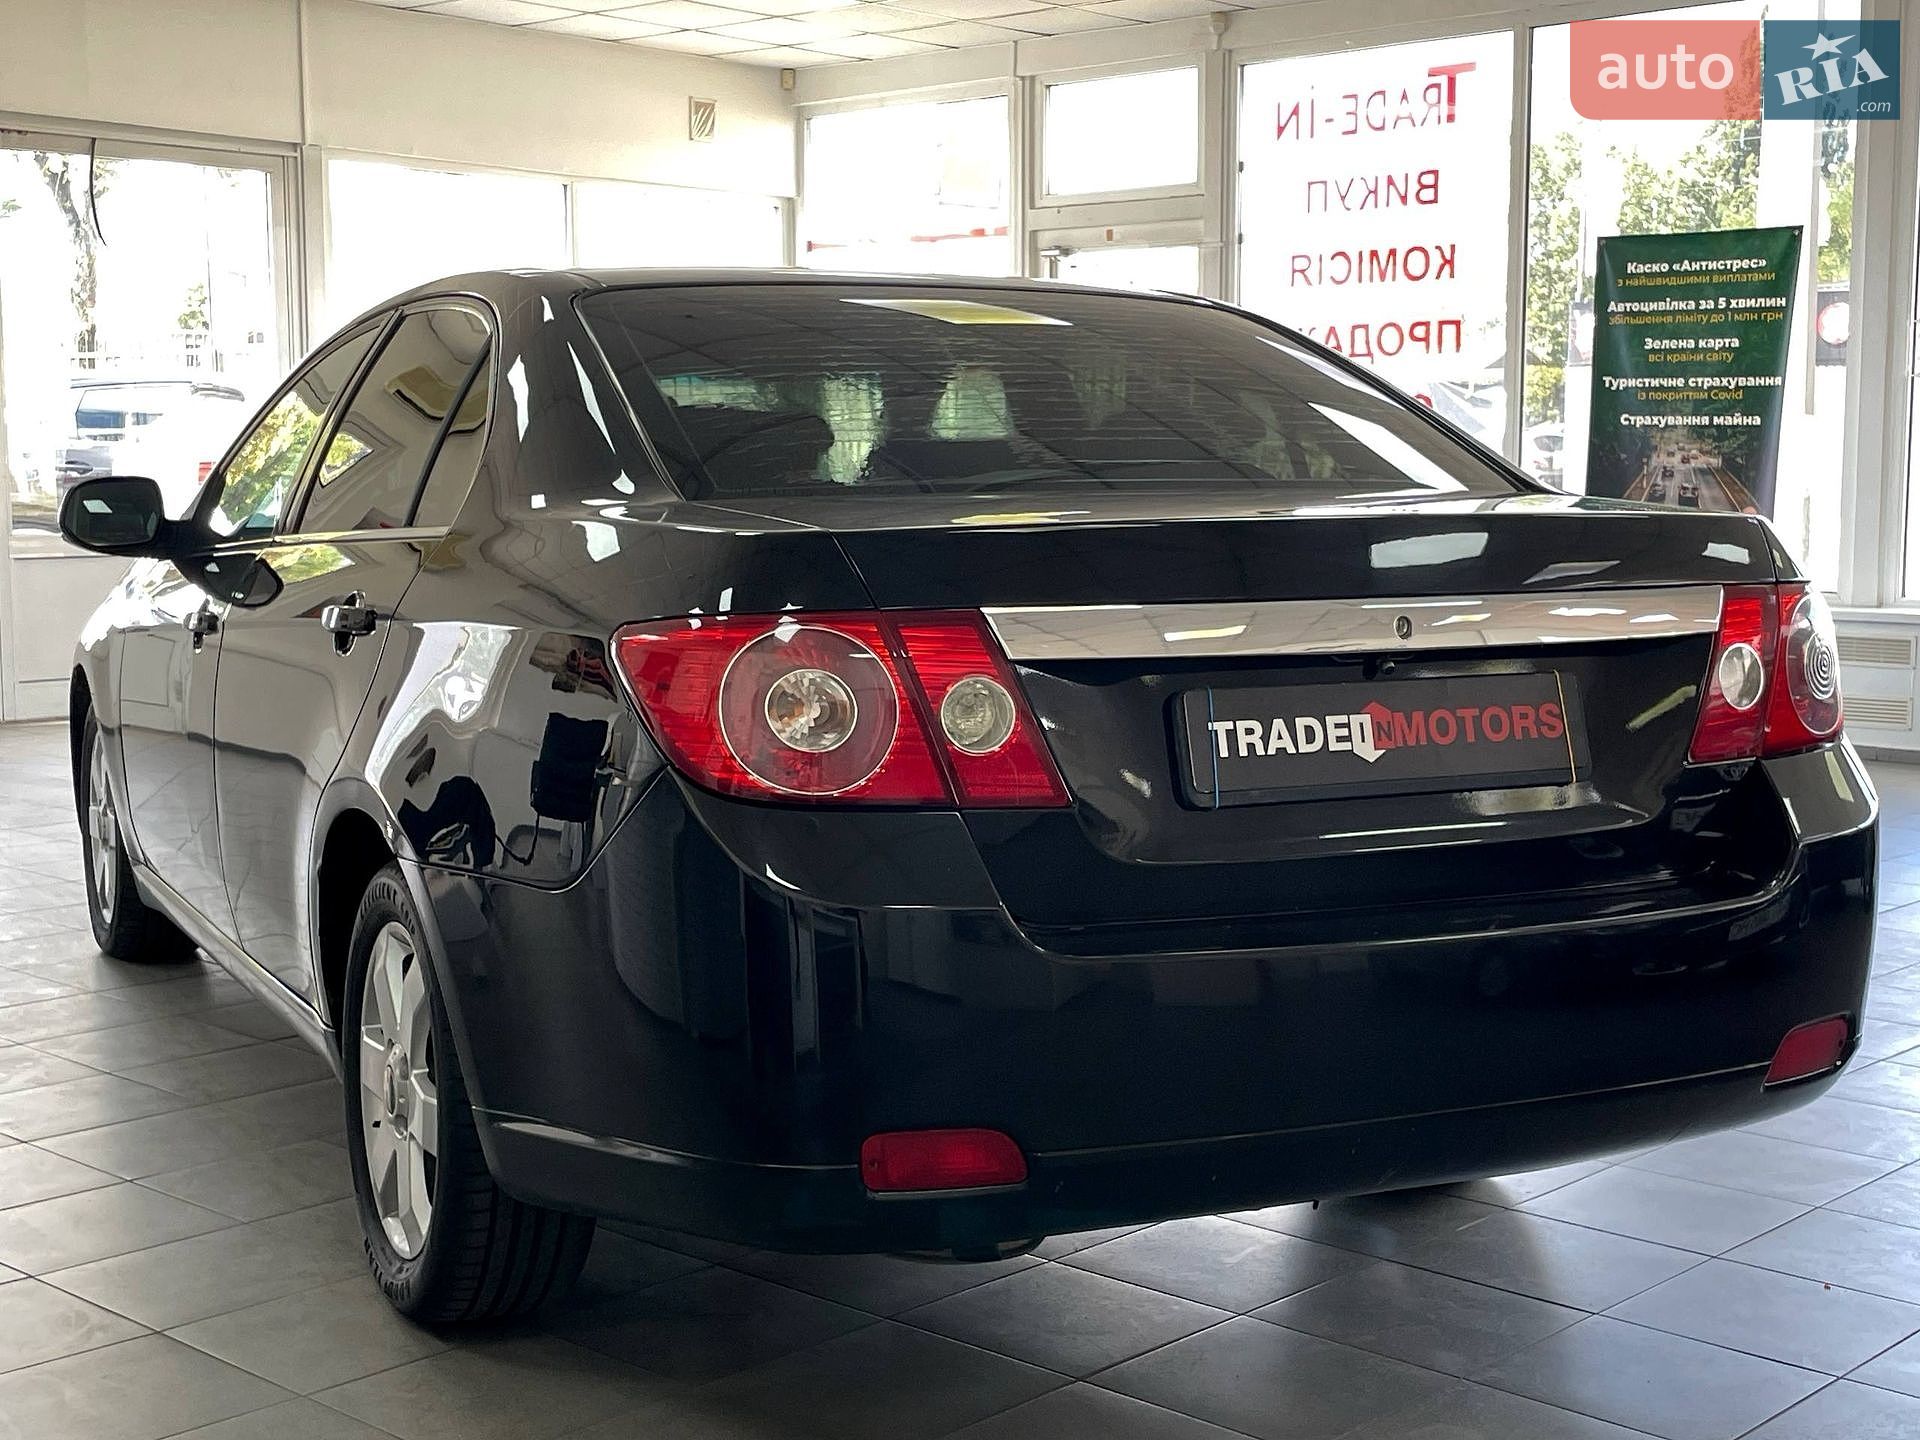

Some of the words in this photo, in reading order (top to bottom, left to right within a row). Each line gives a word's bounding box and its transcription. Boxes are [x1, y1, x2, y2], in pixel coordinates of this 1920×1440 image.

[1626, 262, 1670, 274] Каско
[1672, 258, 1767, 274] «Антистрес»
[1625, 274, 1710, 287] найшвидшими
[1712, 272, 1776, 284] виплатами
[1607, 298, 1696, 313] Автоцивілка
[1698, 299, 1715, 309] за
[1717, 297, 1727, 309] 5
[1729, 296, 1787, 309] хвилин
[1675, 312, 1709, 325] ліміту
[1710, 313, 1725, 324] до
[1734, 312, 1758, 322] млн
[1761, 311, 1783, 323] грн
[1644, 337, 1695, 350] Зелена
[1698, 337, 1740, 351] карта
[1648, 352, 1664, 362] всі
[1706, 351, 1735, 363] світу
[1602, 376, 1686, 391] Туристичне
[1688, 375, 1783, 390] страхування
[1637, 391, 1647, 401] із
[1648, 390, 1708, 402] покриттям
[1711, 389, 1744, 400] Covid
[1620, 413, 1710, 428] Страхування
[1712, 411, 1762, 426] майна
[1392, 703, 1565, 747] MOTORS
